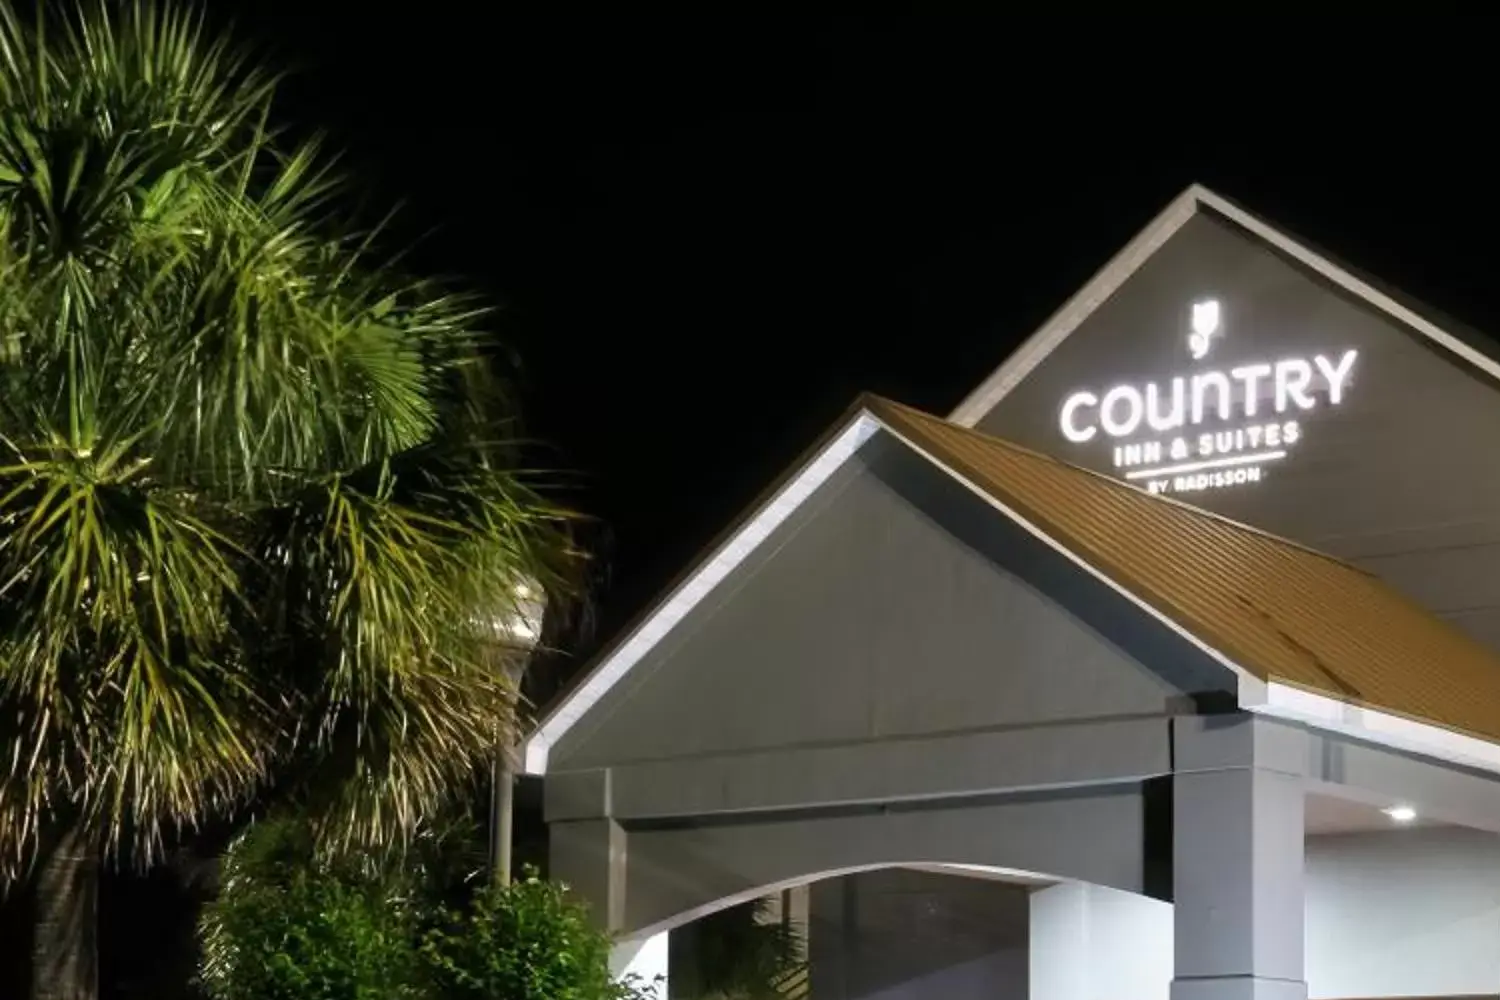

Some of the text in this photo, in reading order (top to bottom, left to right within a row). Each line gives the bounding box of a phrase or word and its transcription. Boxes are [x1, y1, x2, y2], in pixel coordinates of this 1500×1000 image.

[1060, 349, 1358, 443] COUNTRY
[1114, 441, 1161, 467] INN
[1199, 420, 1300, 456] SUITES
[1175, 467, 1260, 491] RADISSON
